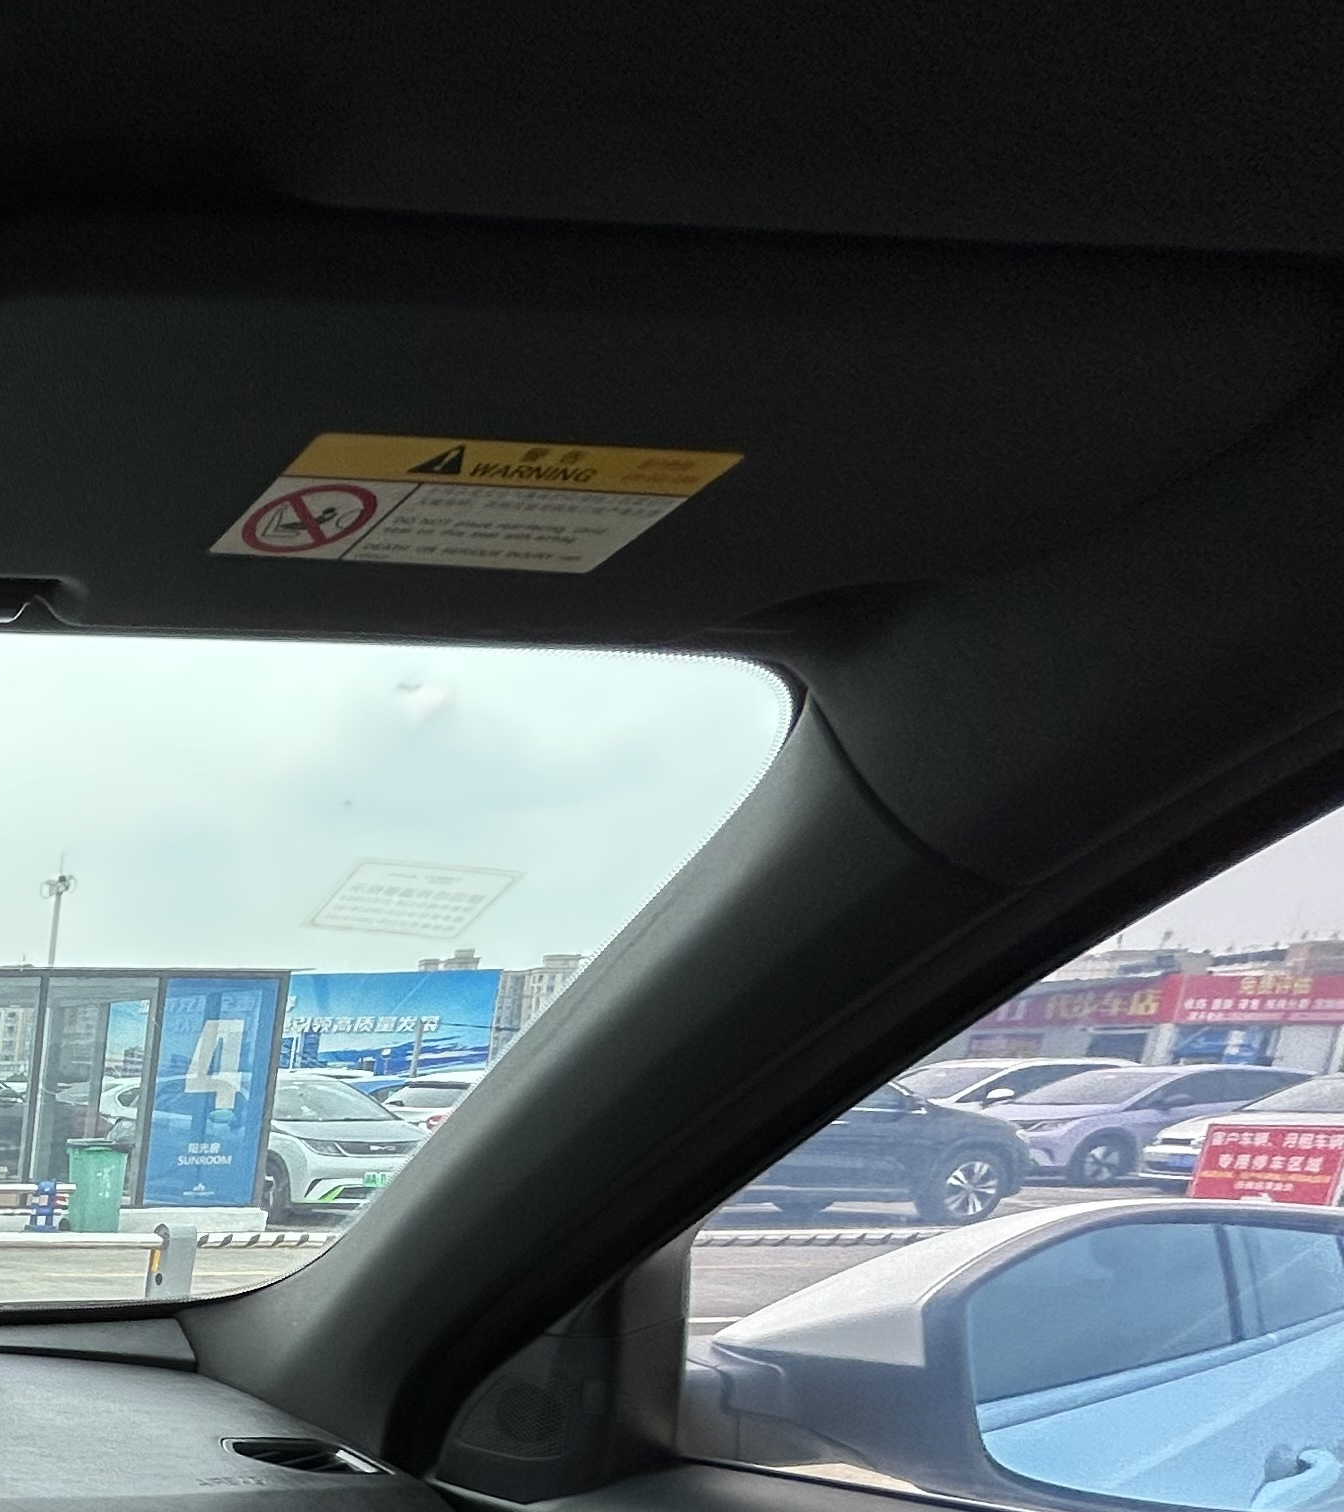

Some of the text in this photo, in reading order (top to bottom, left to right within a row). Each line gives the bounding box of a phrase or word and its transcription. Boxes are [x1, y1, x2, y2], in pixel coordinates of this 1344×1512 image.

[469, 462, 597, 484] WARNING
[184, 1018, 246, 1110] 4
[176, 1154, 233, 1166] SUNROOM
